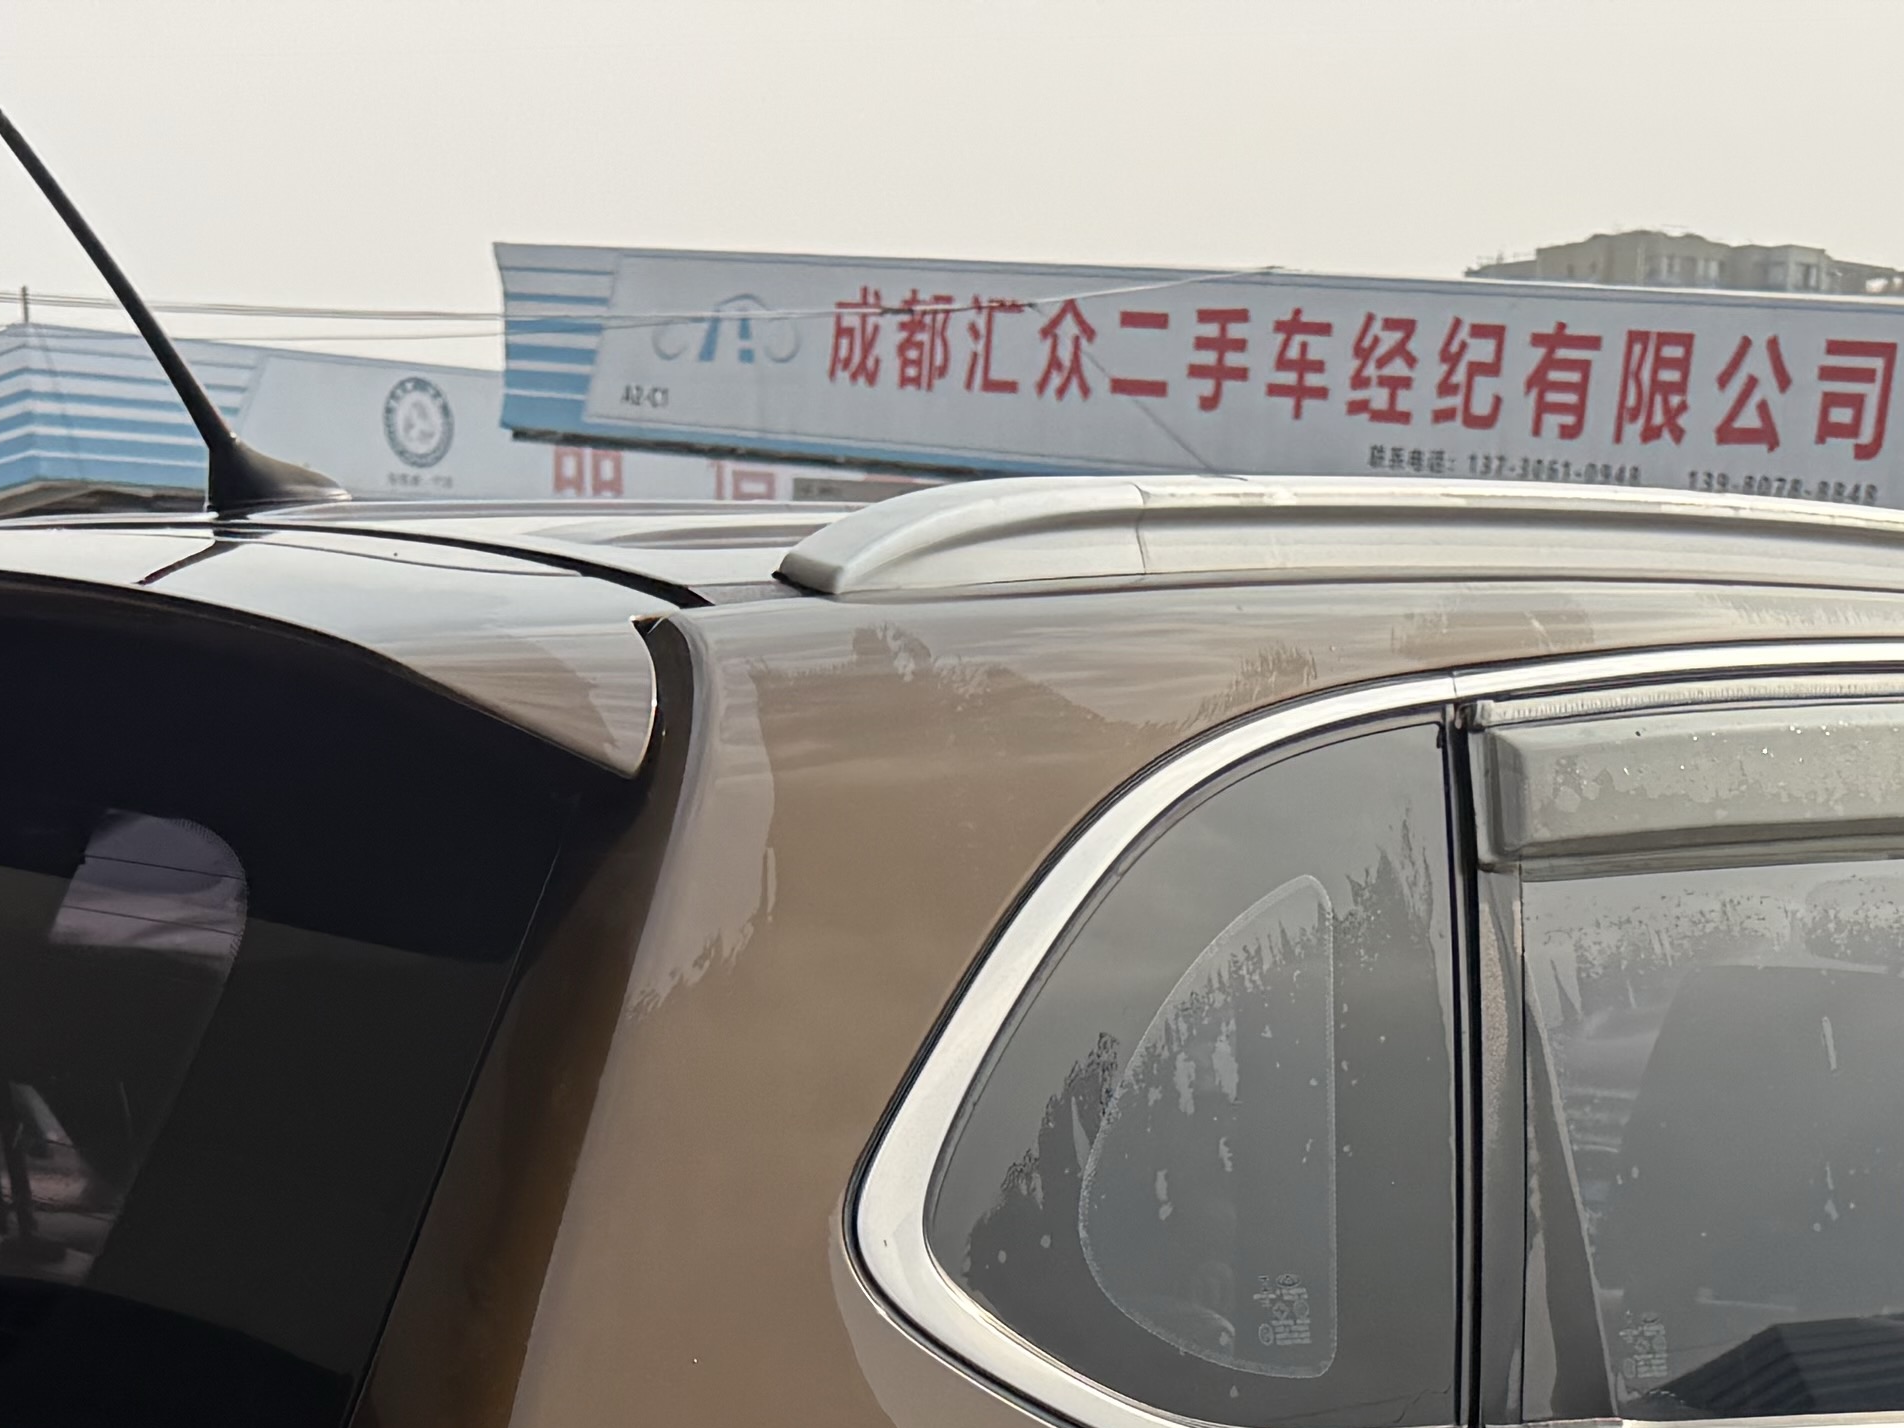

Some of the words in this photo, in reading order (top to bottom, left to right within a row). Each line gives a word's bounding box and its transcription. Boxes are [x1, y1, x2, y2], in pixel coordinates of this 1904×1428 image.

[828, 286, 1899, 462] 成都汇众二手车经纪有限公司
